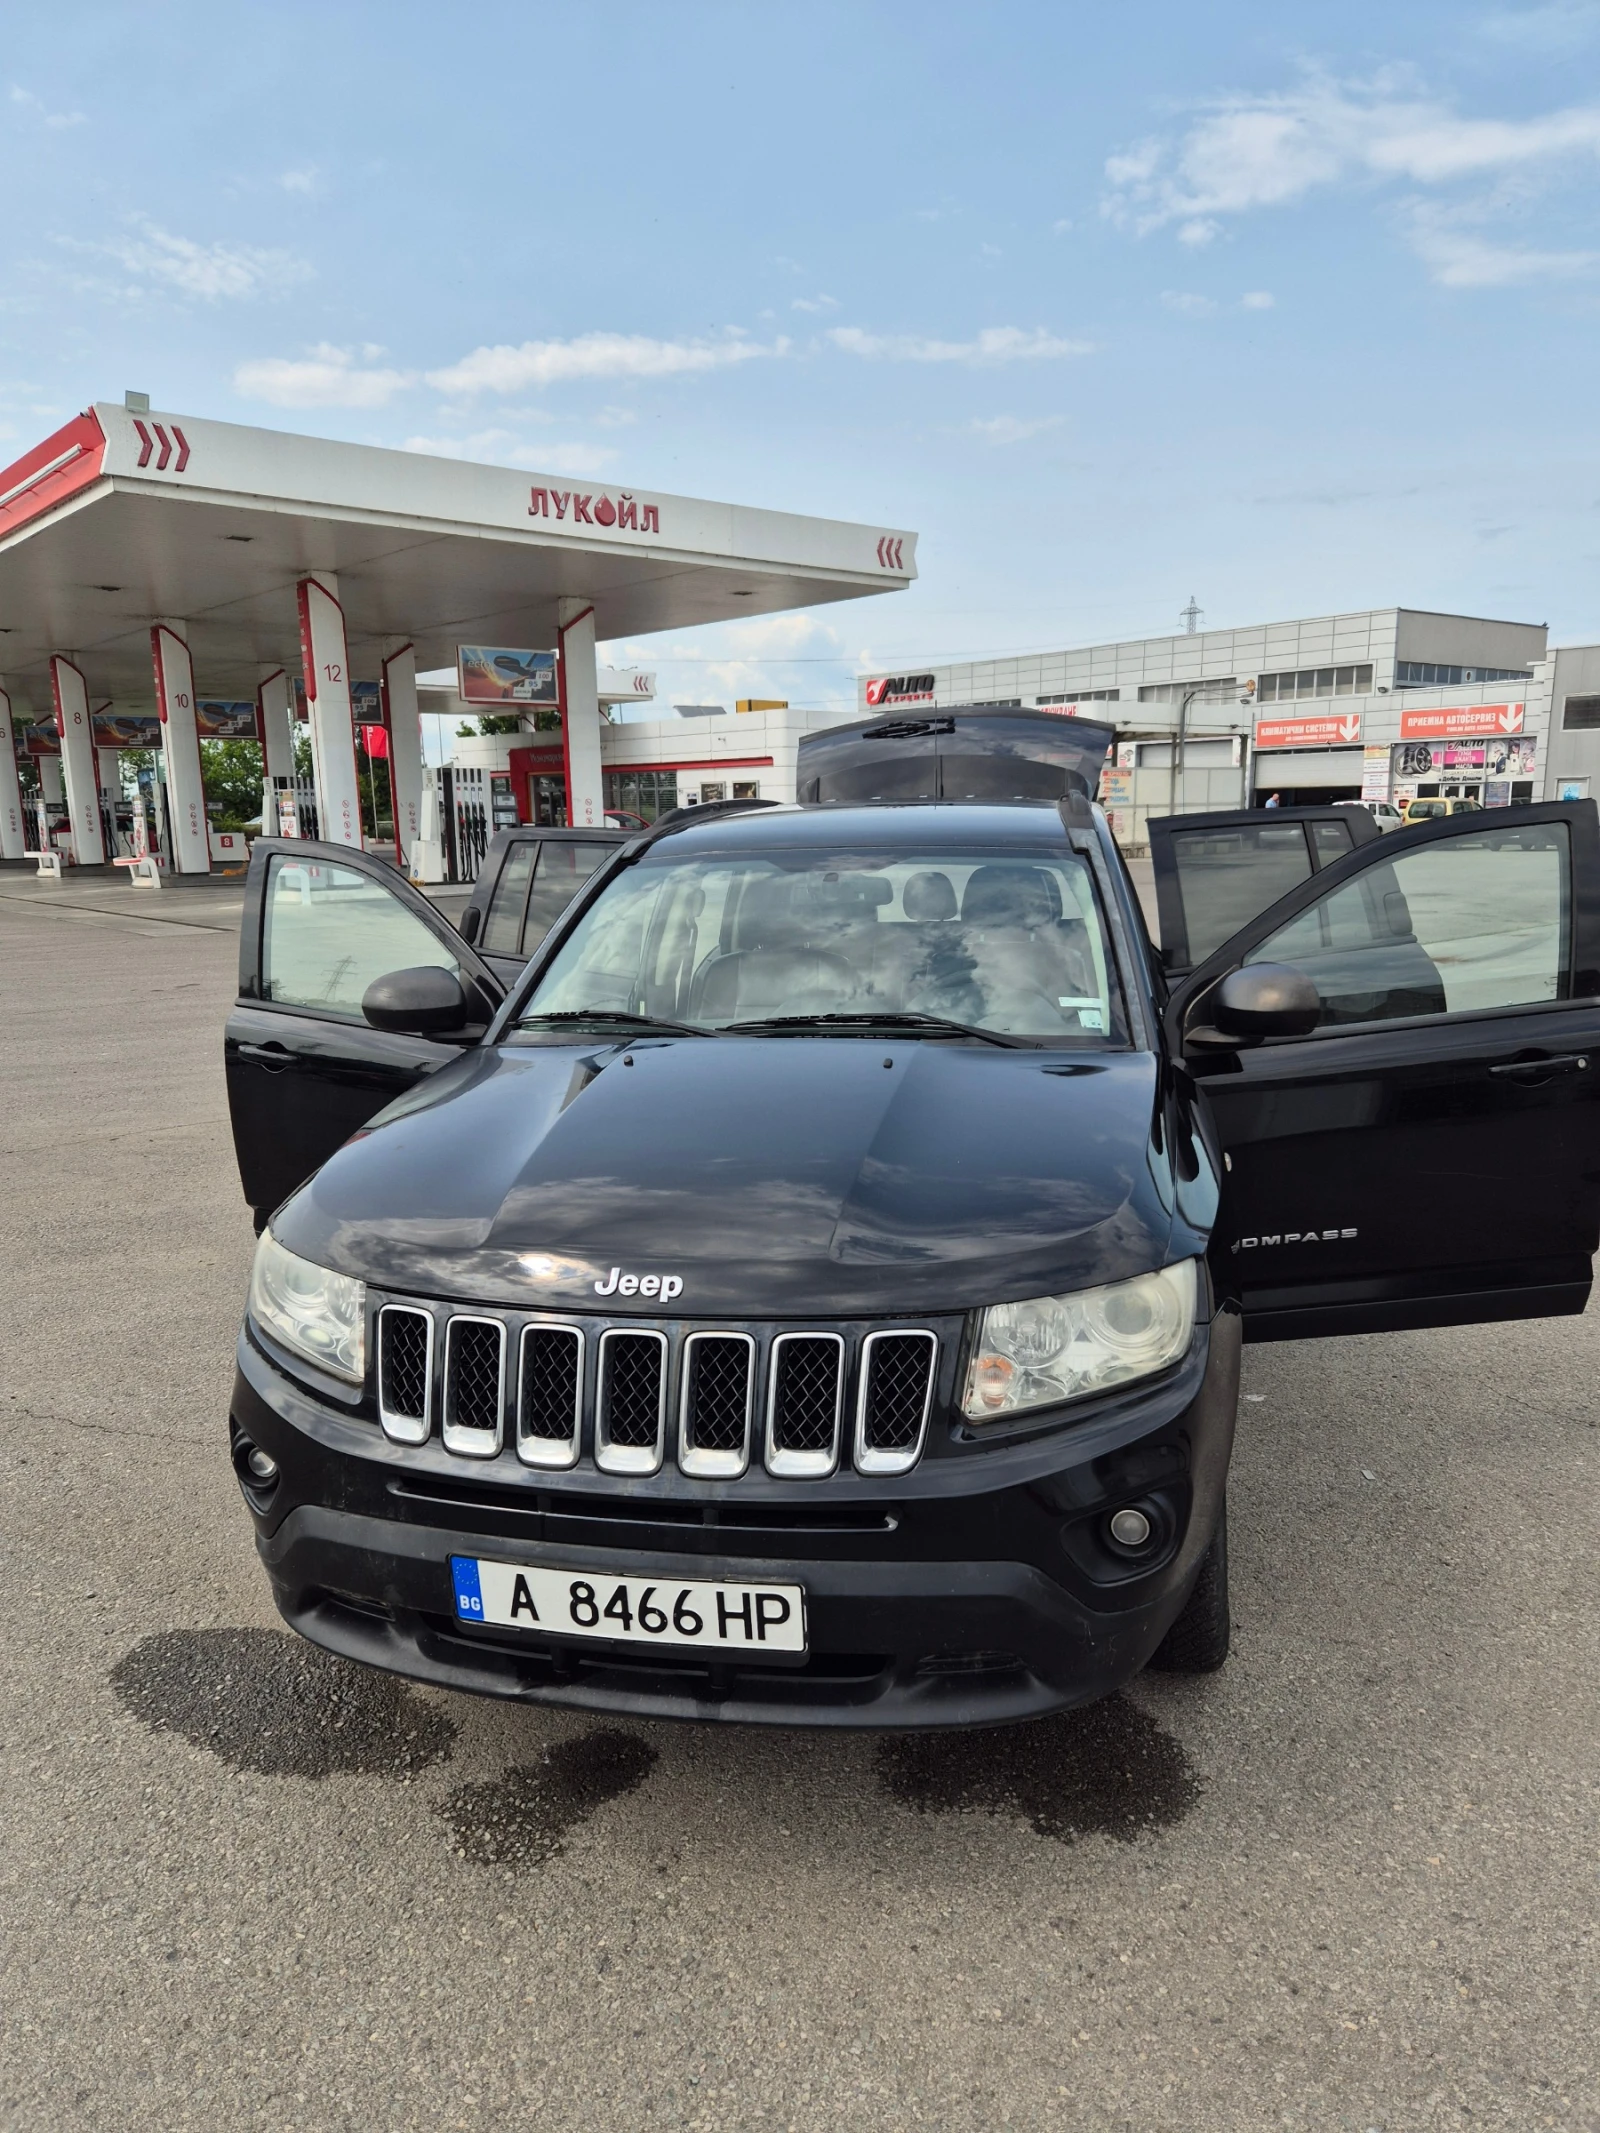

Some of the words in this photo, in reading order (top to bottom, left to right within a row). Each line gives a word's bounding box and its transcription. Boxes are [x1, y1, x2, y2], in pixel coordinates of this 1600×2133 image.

[528, 486, 659, 533] ЛУКОЙЛ
[324, 664, 342, 682] 12
[881, 674, 935, 703] AUTO
[174, 693, 189, 708] 10
[73, 712, 82, 724] 8
[1407, 715, 1444, 727] ПРИЕМНА
[1446, 713, 1496, 725] АВТОСЕРВИЗ
[1261, 725, 1304, 737] КЛИМАТИЧНИ
[1305, 722, 1338, 734] СИСТЕМИ
[594, 1267, 684, 1303] Jeep
[460, 1595, 481, 1611] BG
[510, 1573, 540, 1621] A
[569, 1581, 704, 1636] 8466
[716, 1591, 791, 1641] HP
